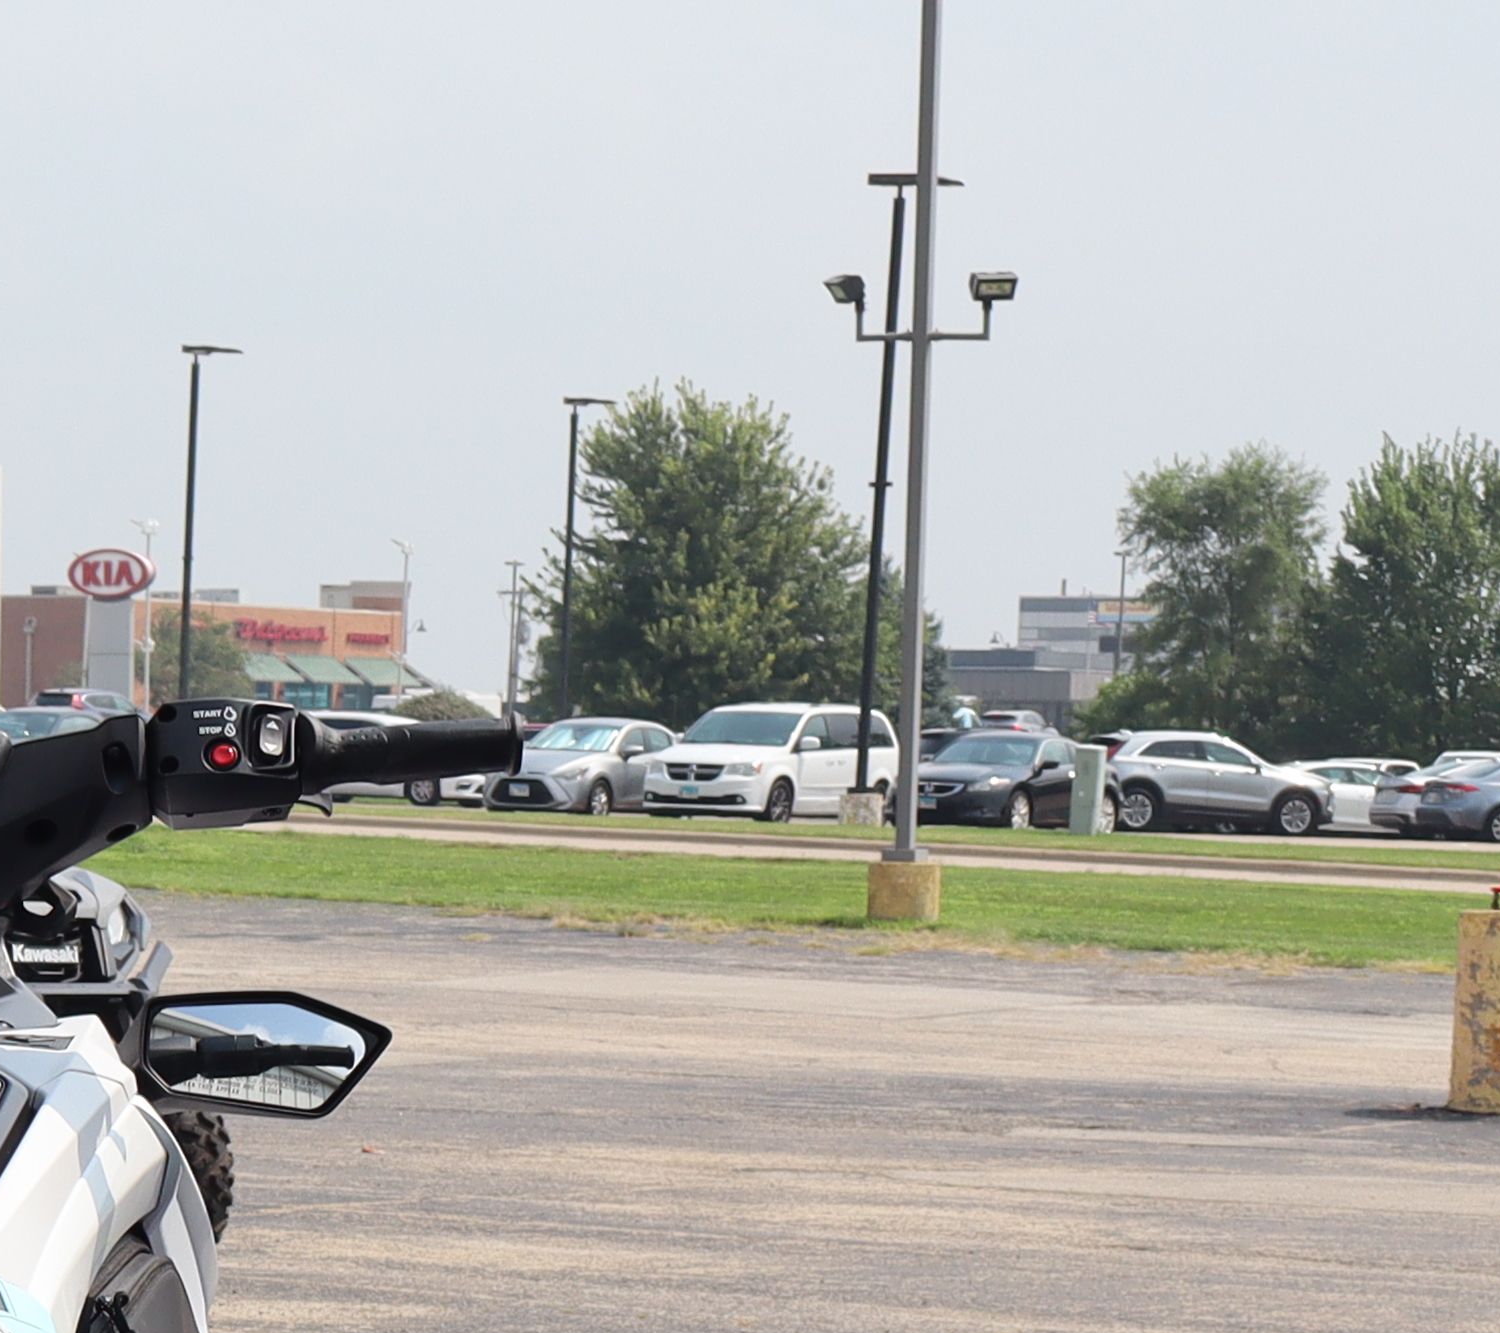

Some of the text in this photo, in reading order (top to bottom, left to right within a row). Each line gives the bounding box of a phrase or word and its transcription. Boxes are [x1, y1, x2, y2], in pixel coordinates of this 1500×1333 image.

[81, 560, 137, 587] KIA
[193, 708, 222, 719] START
[199, 726, 222, 735] STOP
[11, 943, 80, 963] Kawasaki
